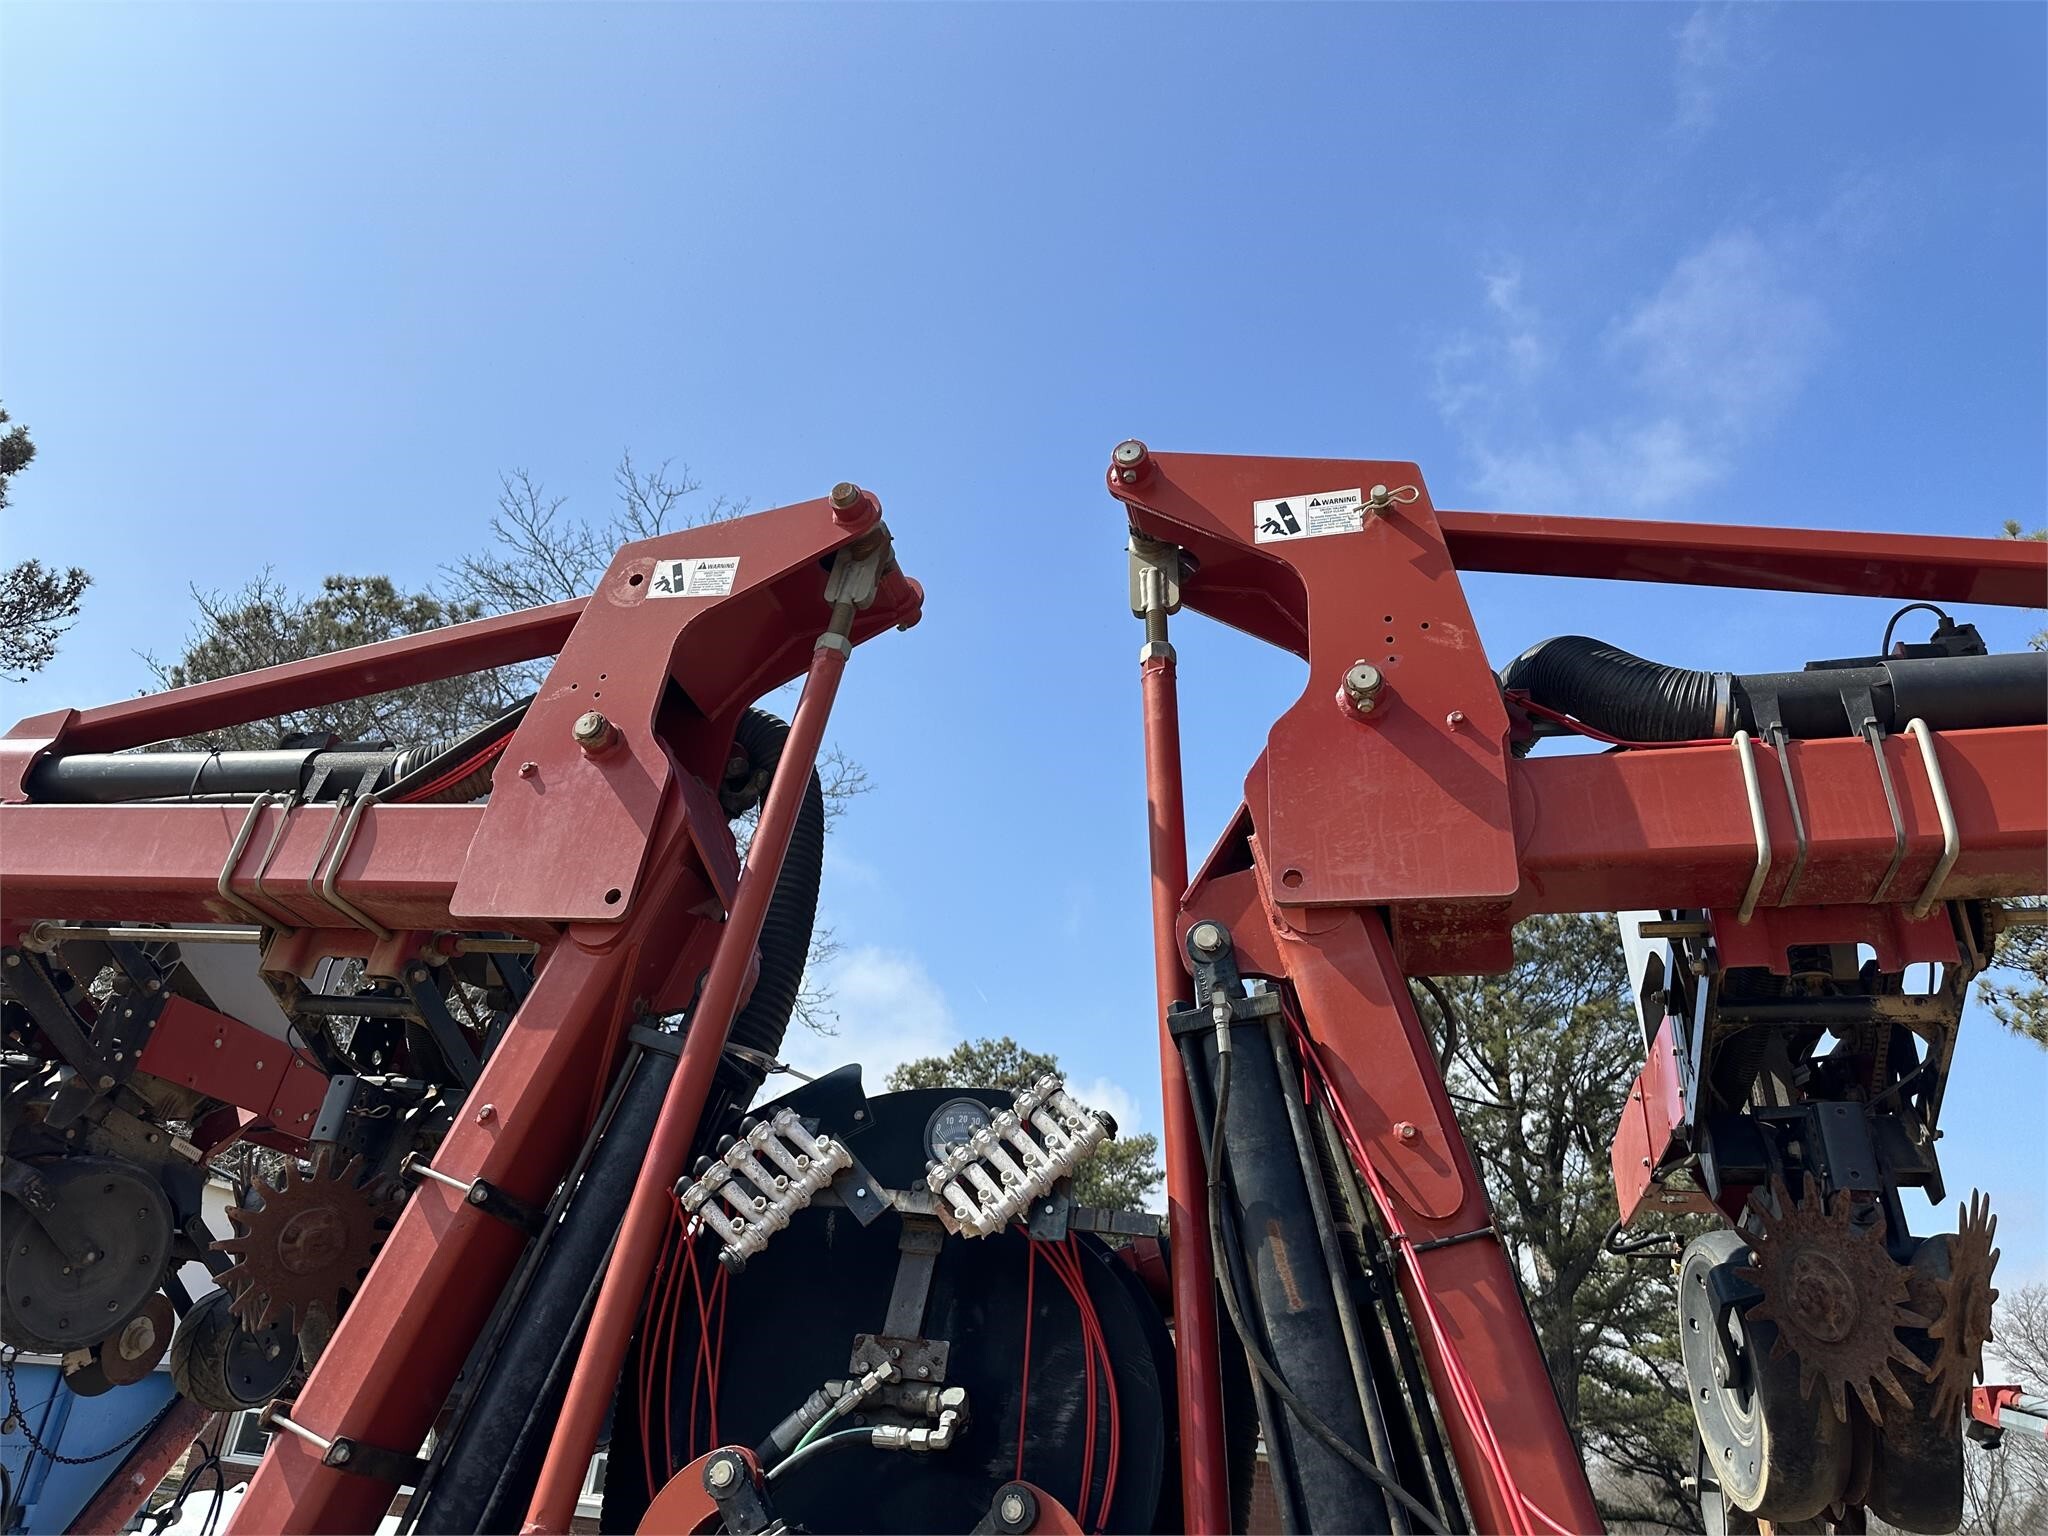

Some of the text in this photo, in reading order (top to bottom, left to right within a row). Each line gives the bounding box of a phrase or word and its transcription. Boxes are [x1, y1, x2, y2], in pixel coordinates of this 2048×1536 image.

[1322, 496, 1357, 505] WARNING
[946, 1116, 954, 1125] 10
[958, 1114, 968, 1123] 20
[971, 1117, 981, 1125] 30
